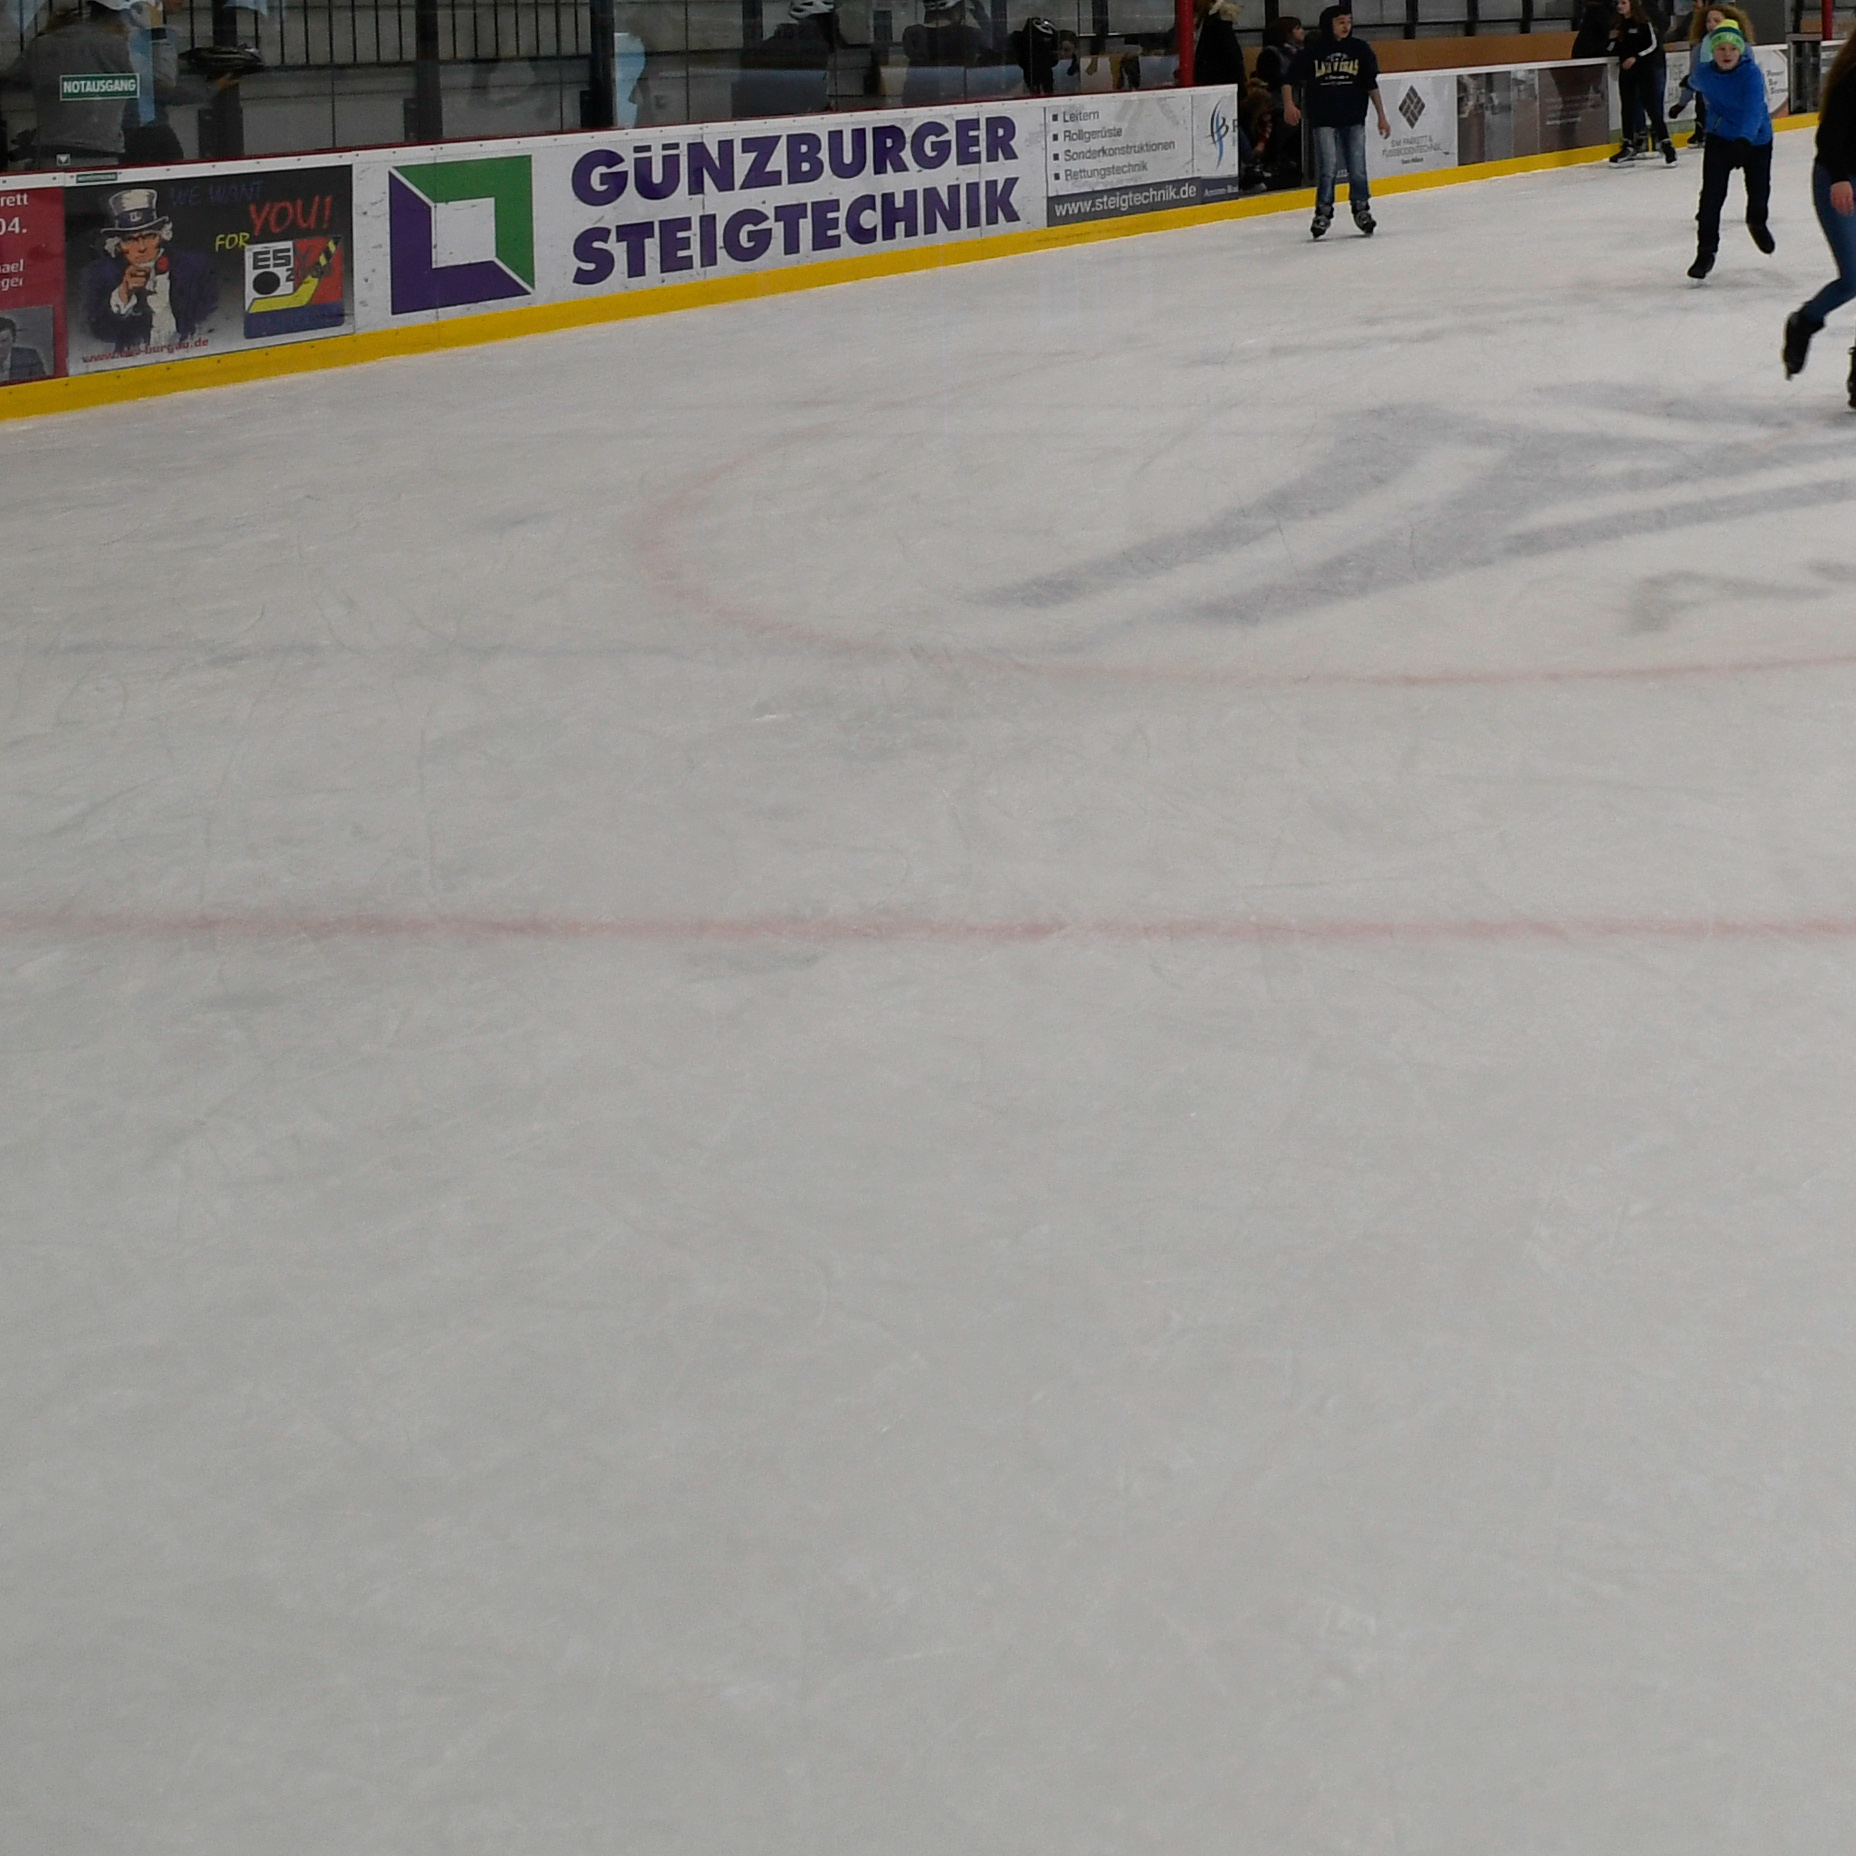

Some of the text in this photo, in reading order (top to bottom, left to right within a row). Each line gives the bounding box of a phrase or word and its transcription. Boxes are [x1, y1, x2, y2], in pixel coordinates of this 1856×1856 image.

[1332, 58, 1359, 76] VEGAS
[63, 79, 136, 94] NOTAUSGANG
[1063, 109, 1100, 124] Leitern
[1063, 126, 1124, 144] Rollgerüste
[571, 115, 1019, 207] GÜNZBURGER
[1064, 140, 1176, 162] Sonderkonstruktionen
[1064, 159, 1149, 182] Rettungstechnik
[1054, 181, 1197, 217] www.steigtechnik.de
[249, 194, 334, 237] YOU!
[215, 231, 251, 253] FOR
[573, 176, 1021, 286] STEIGTECHNIK
[0, 258, 24, 274] ael
